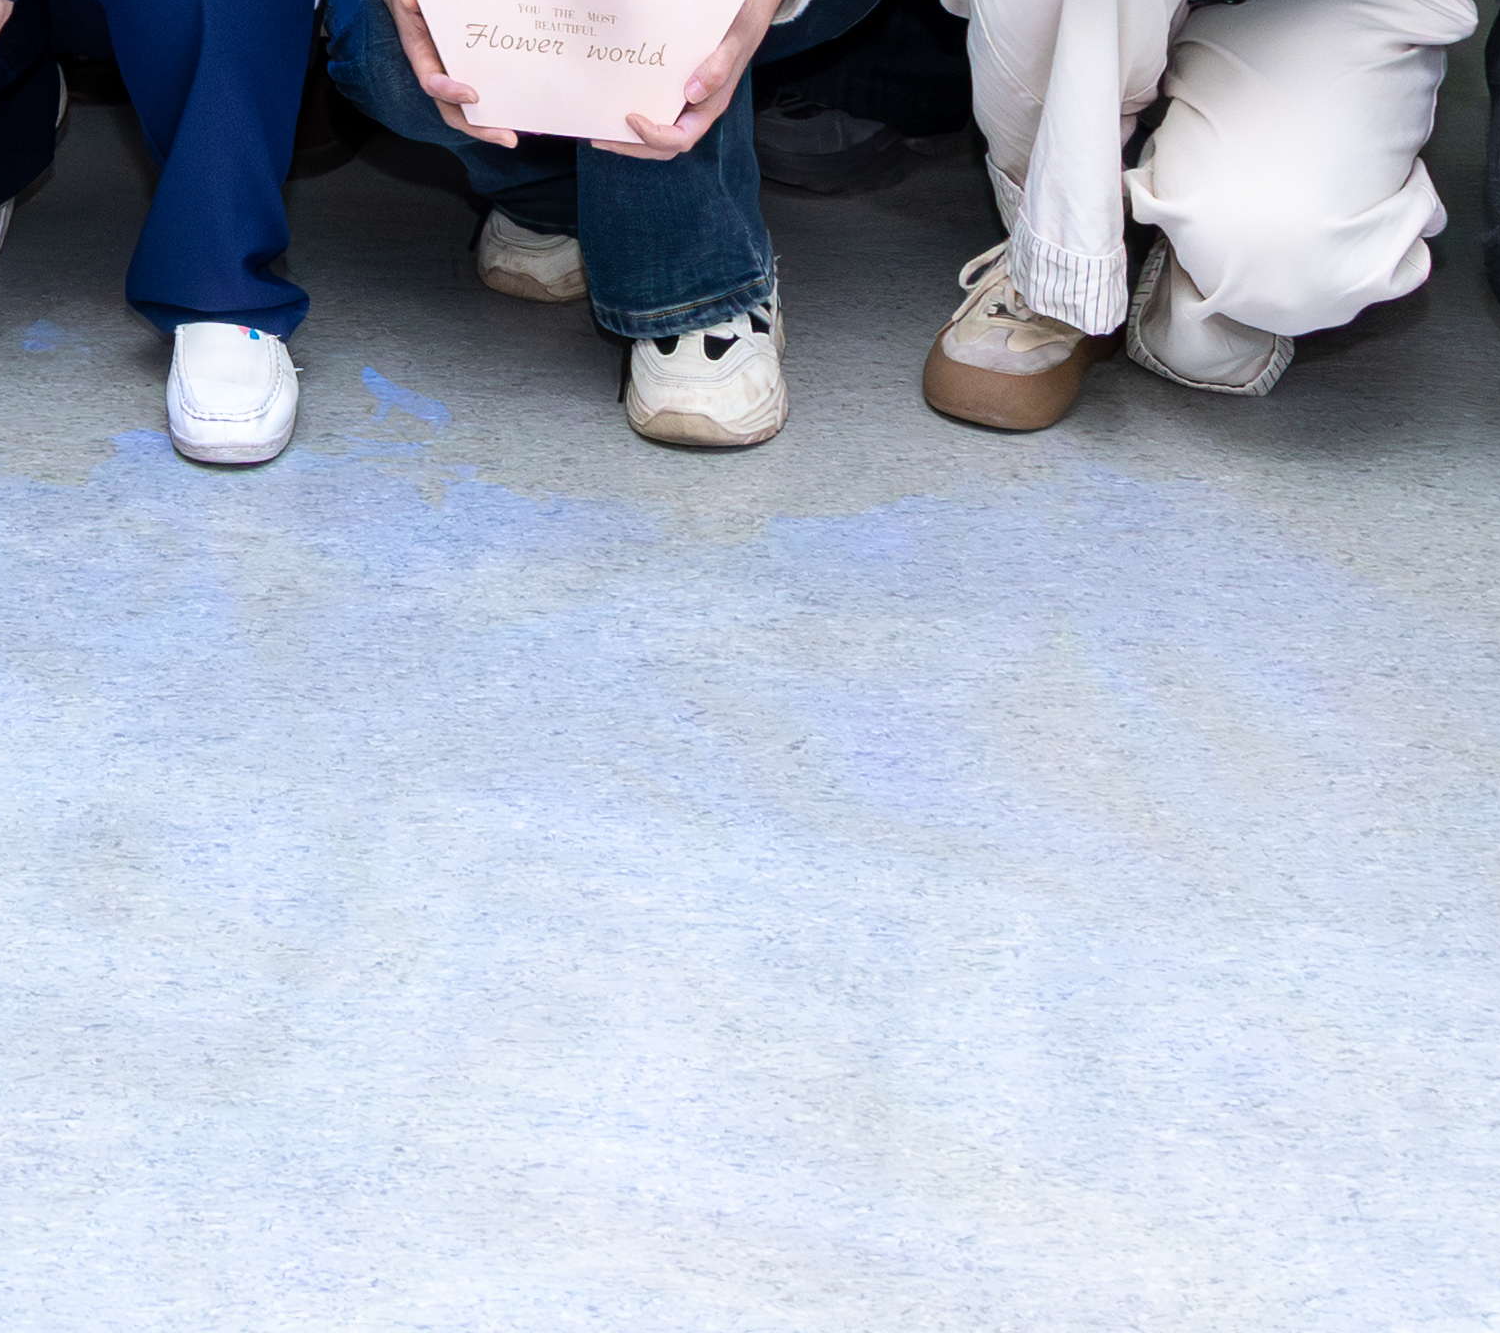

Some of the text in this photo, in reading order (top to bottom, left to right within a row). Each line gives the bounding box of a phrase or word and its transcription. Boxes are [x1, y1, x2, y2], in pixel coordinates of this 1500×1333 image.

[518, 3, 618, 24] YOU THE MOST
[534, 20, 598, 36] BEAUTIFUL
[465, 23, 667, 66] Flower world
